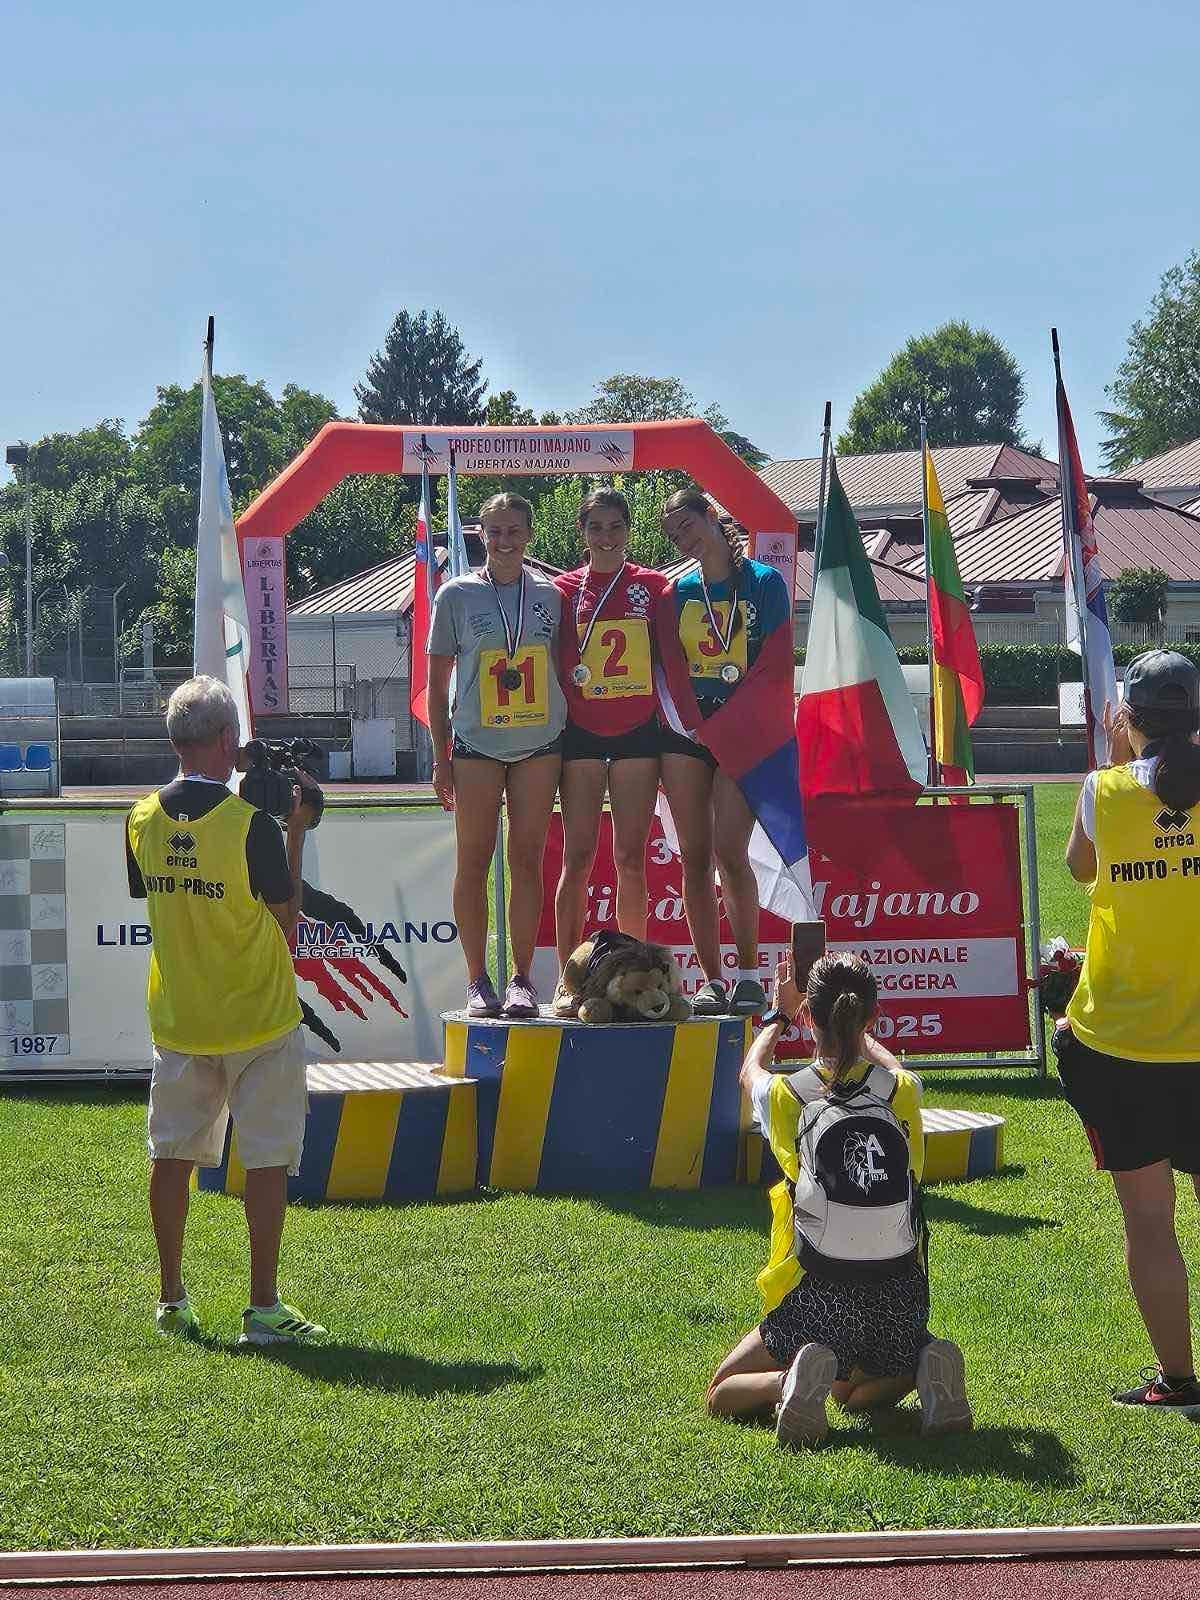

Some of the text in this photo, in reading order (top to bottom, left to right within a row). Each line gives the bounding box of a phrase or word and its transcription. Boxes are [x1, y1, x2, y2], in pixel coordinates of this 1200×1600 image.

[448, 438, 493, 454] TROFEO
[530, 438, 541, 453] DI
[544, 438, 591, 453] MAJANO
[467, 458, 570, 470] LIBERTAS MAJANO
[259, 576, 278, 708] LIBERTAS
[698, 608, 724, 657] 3
[601, 629, 629, 678] 2
[489, 656, 536, 706] 11
[1110, 859, 1168, 883] PHOTO
[1181, 856, 1200, 877] PR
[96, 920, 459, 946] LIB MAJANO
[293, 945, 379, 959] EGGERA
[875, 973, 958, 991] EGGERA
[873, 1013, 943, 1039] 025
[11, 1035, 58, 1054] 1987
